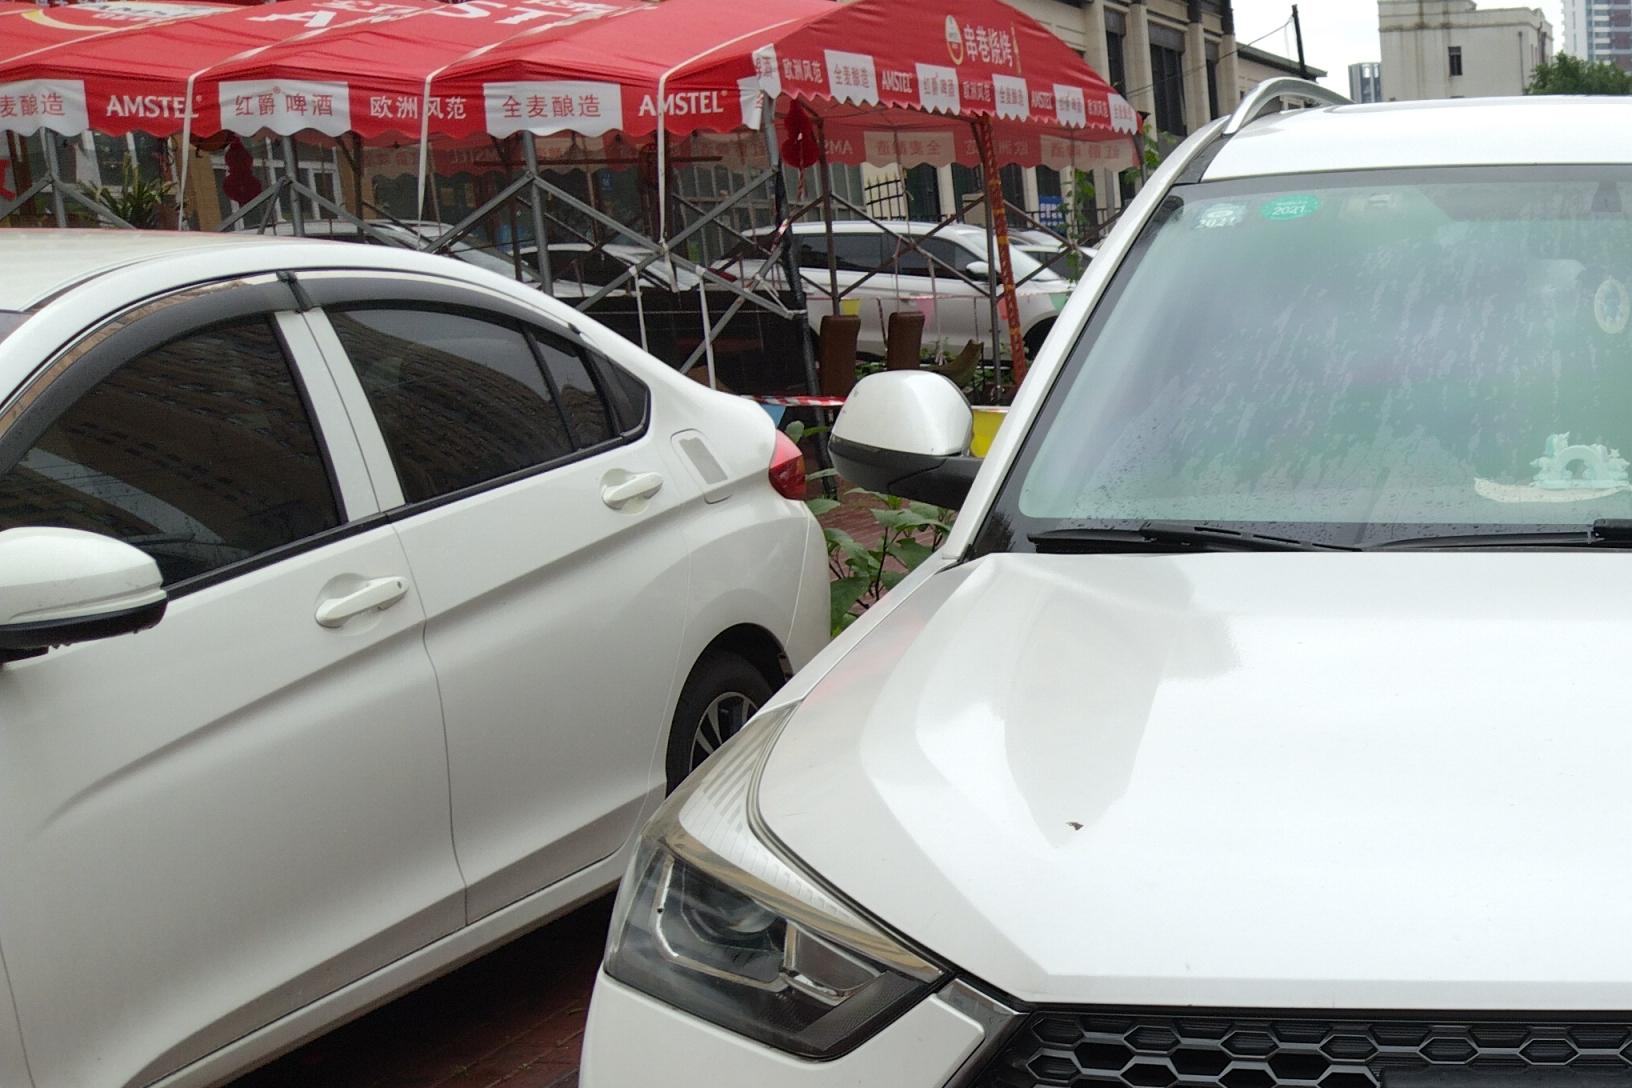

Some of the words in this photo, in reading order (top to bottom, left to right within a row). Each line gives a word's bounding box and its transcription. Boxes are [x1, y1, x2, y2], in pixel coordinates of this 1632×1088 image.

[369, 96, 466, 119] 欧洲风范
[502, 94, 601, 118] 全麦酿造
[1272, 204, 1305, 216] 2021
